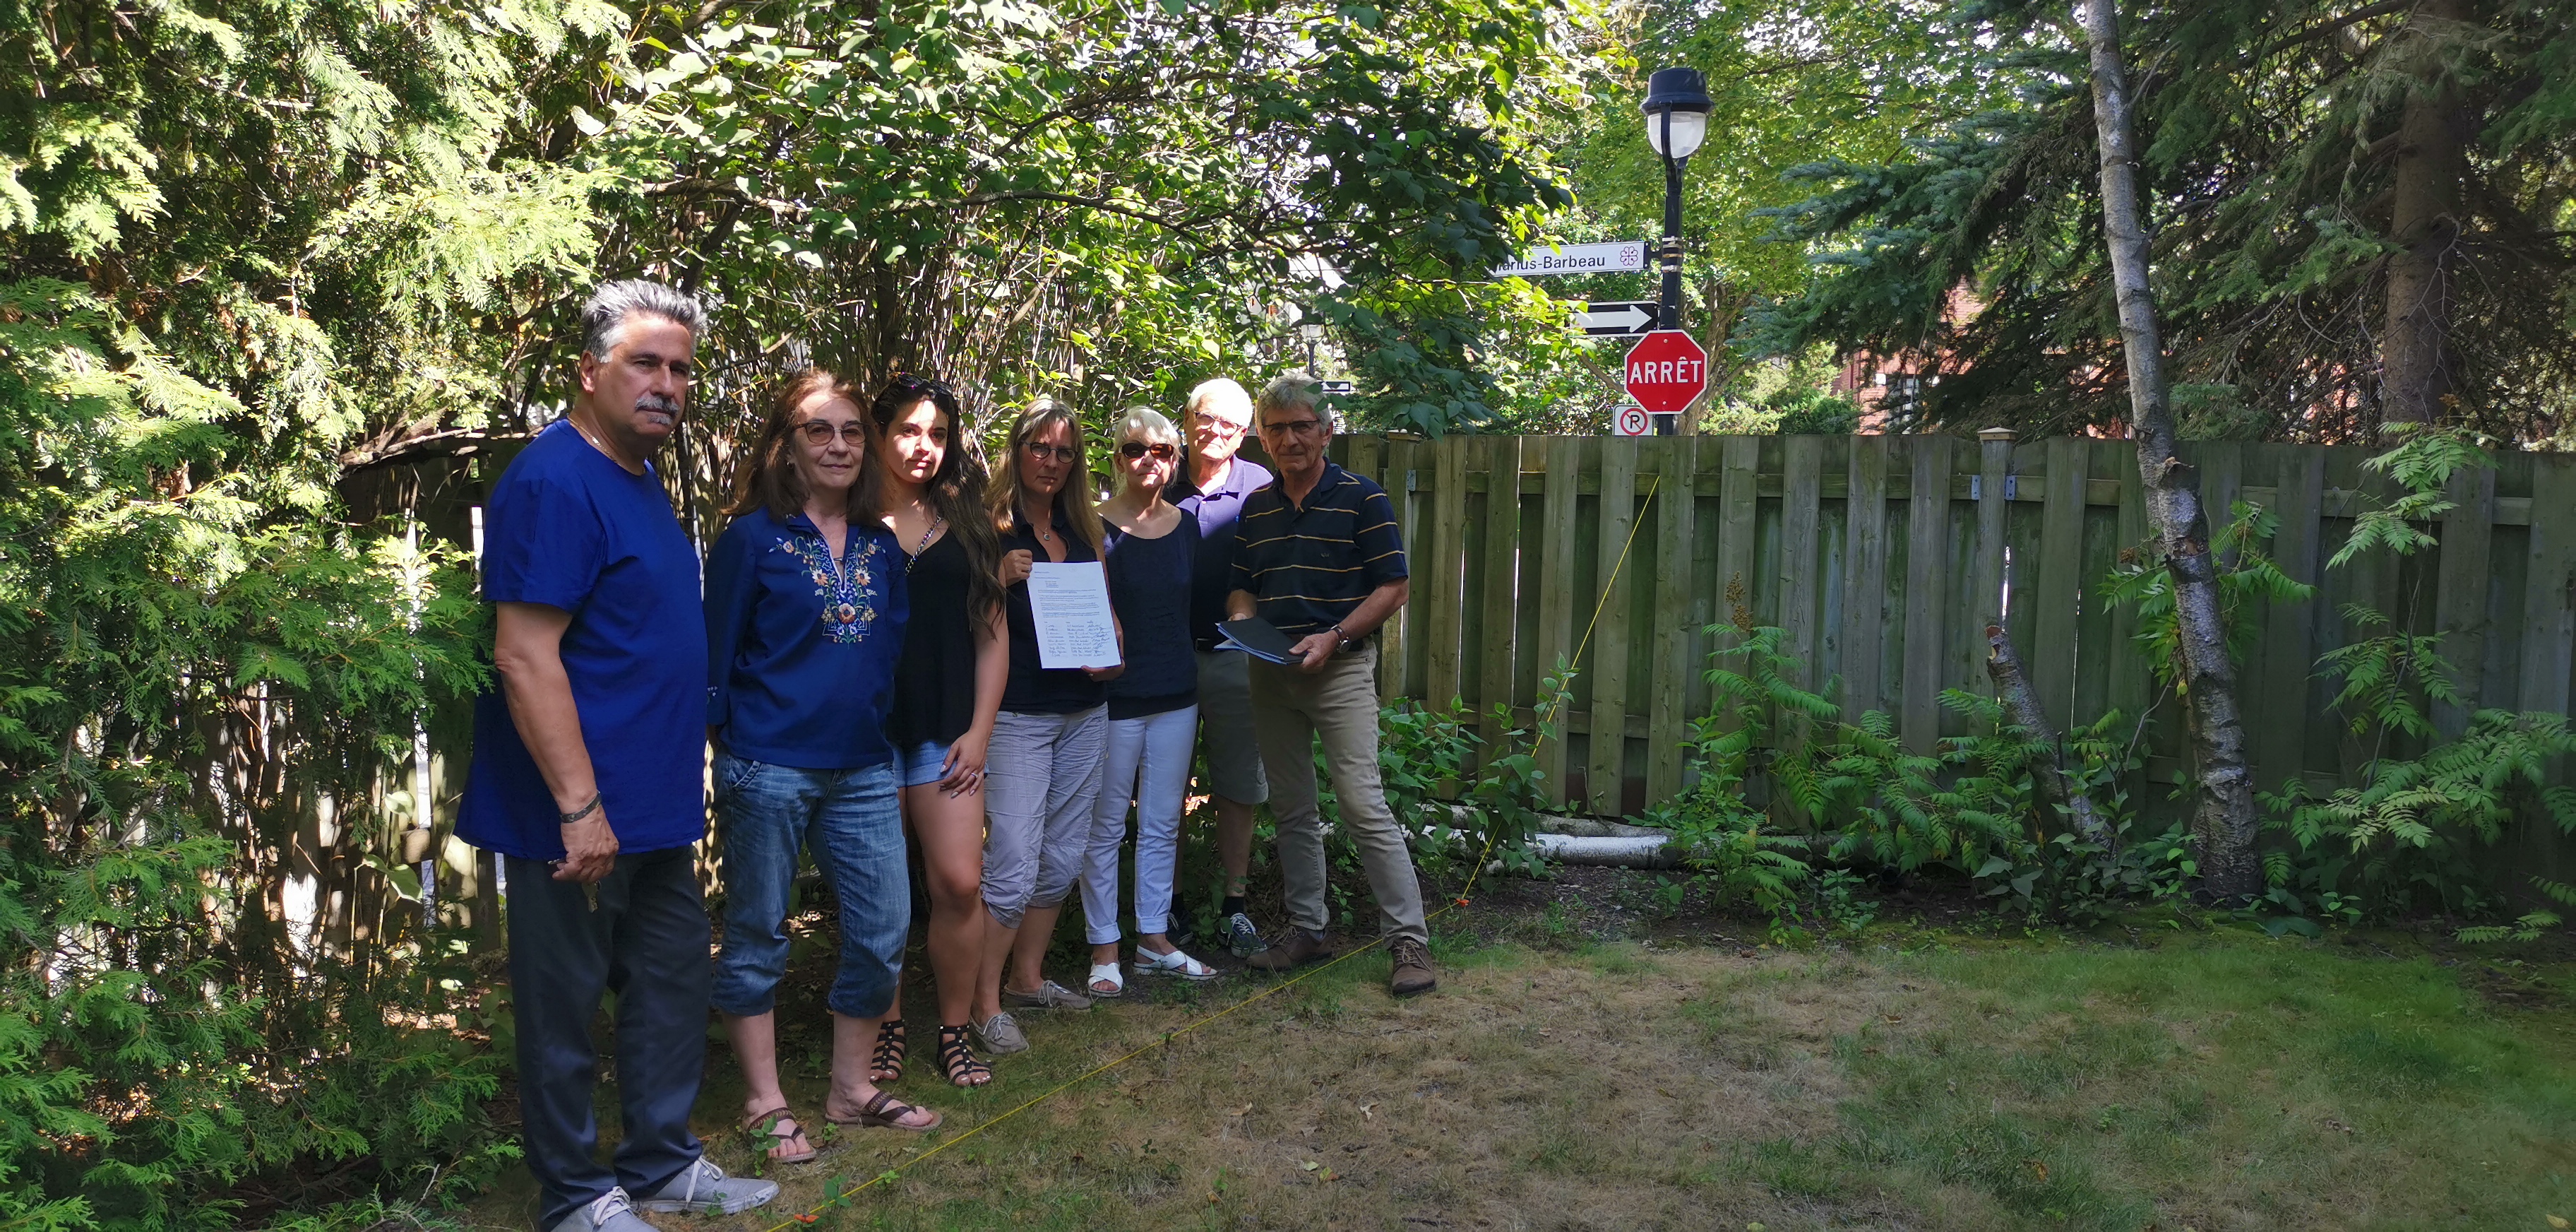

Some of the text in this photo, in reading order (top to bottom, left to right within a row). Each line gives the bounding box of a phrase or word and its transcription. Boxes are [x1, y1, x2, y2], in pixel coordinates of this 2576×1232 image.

[1498, 255, 1605, 271] arius-Barbeau
[1629, 356, 1702, 384] ARRÊT
[1630, 415, 1640, 429] P
